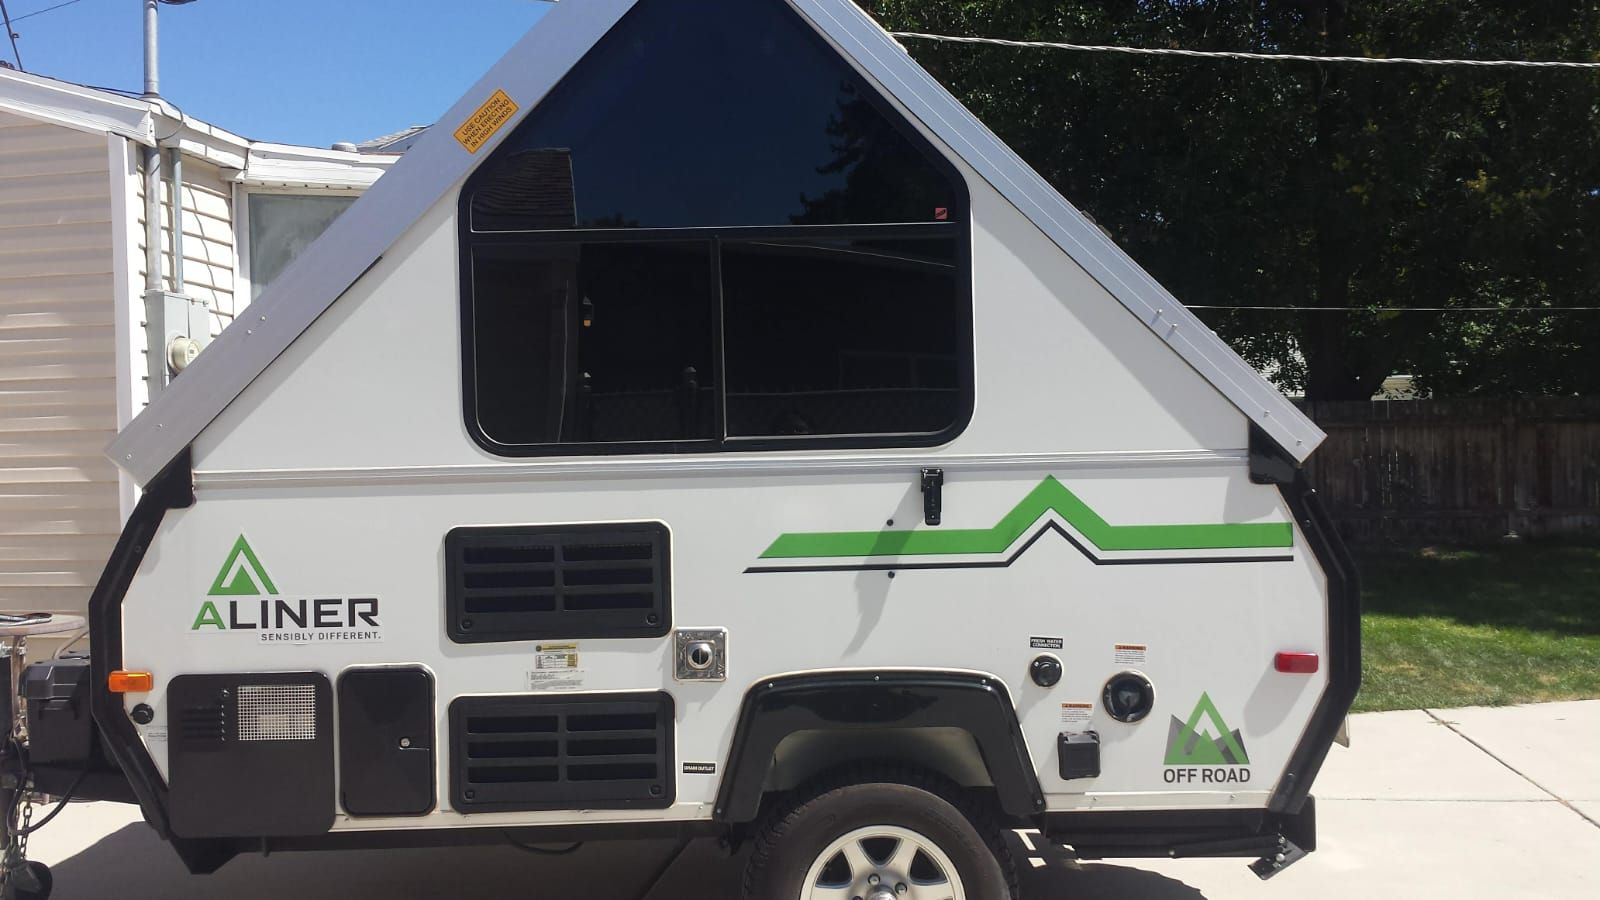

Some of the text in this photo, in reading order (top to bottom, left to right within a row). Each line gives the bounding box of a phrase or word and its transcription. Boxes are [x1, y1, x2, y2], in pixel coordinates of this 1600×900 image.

[462, 97, 500, 136] USE CAUTION
[463, 99, 509, 145] WHEN ERECTING
[471, 107, 512, 147] IN HIGH WINDS
[191, 598, 380, 630] ALINER
[261, 631, 381, 641] SENSIBLY DIFFERENT.
[1163, 767, 1251, 783] OFF ROAD
